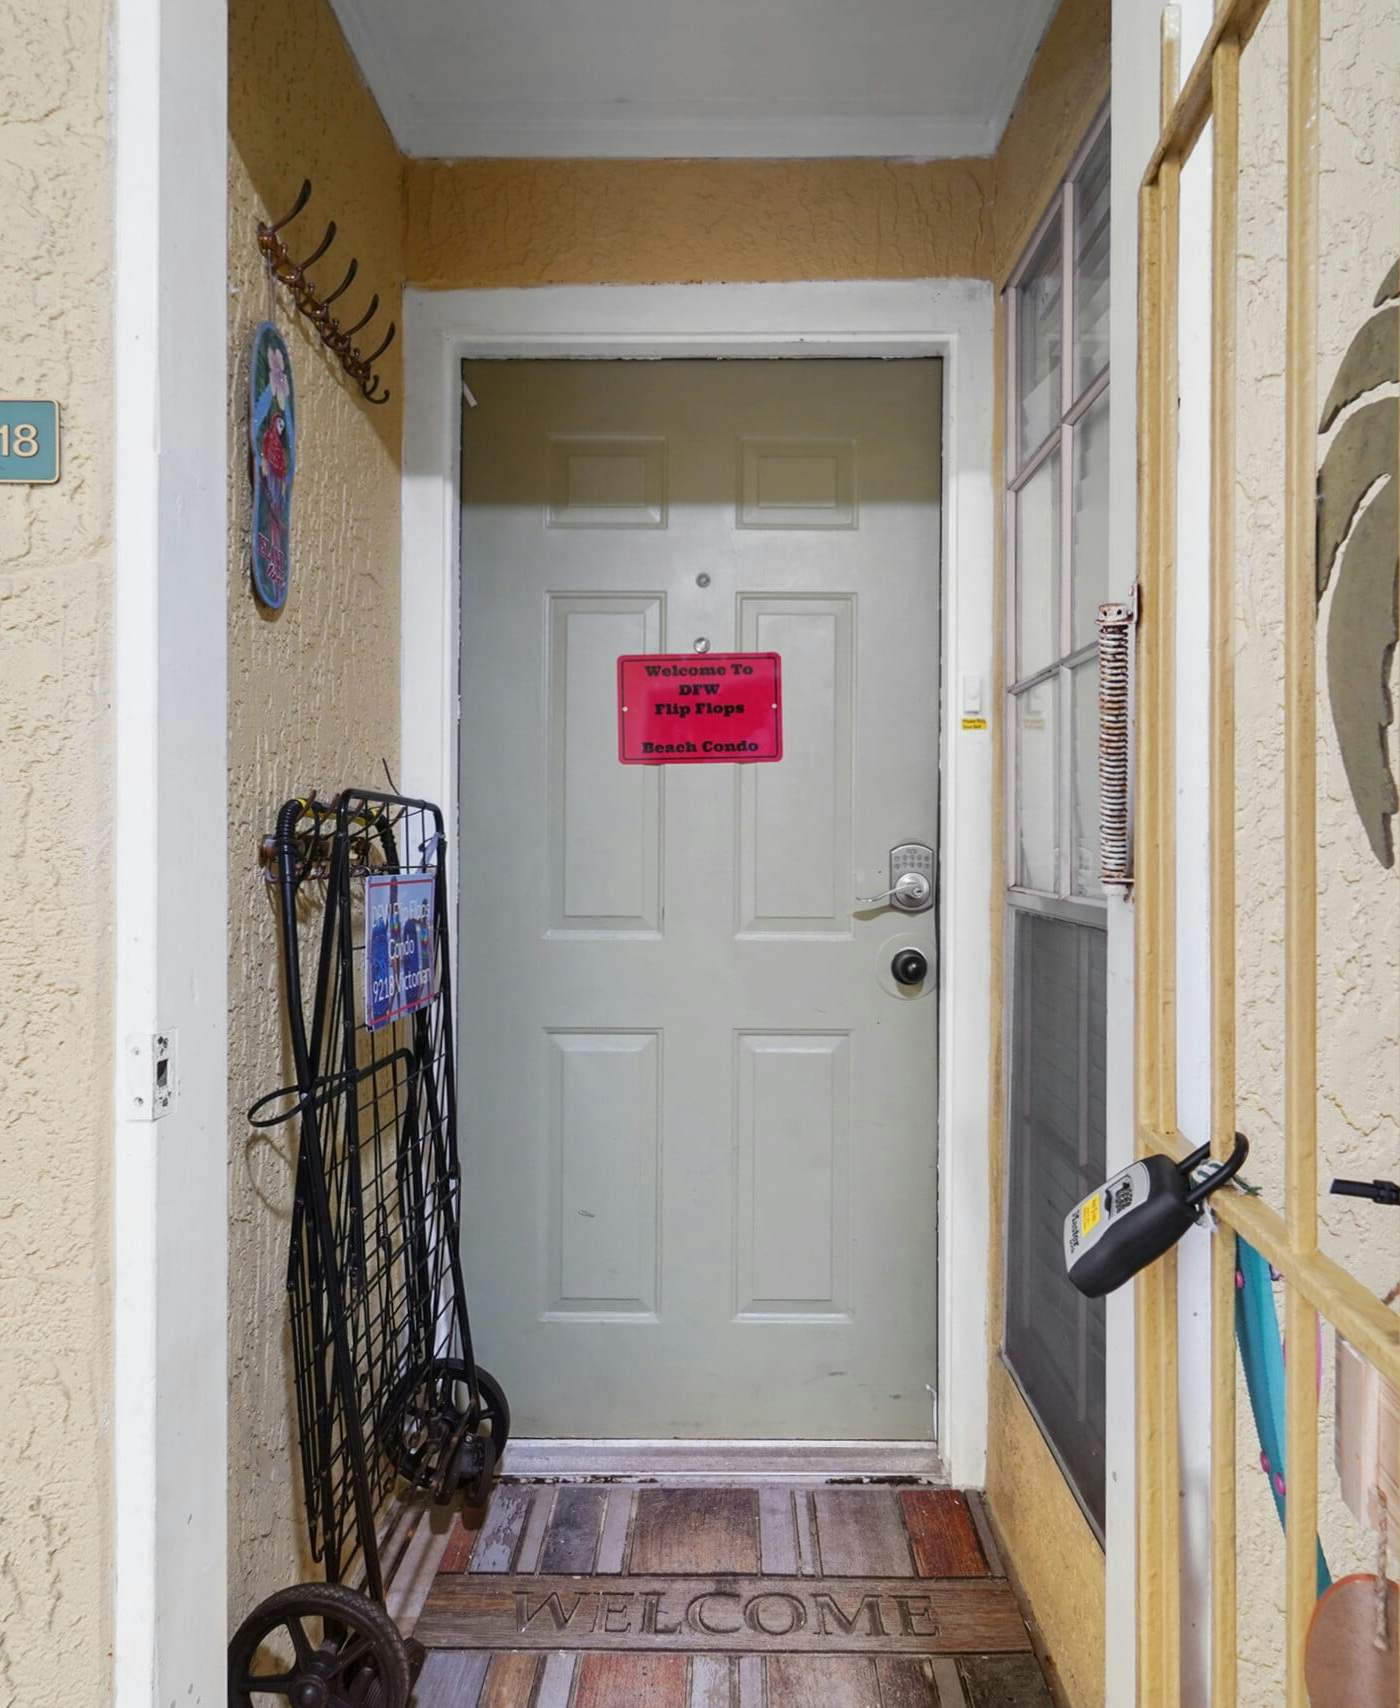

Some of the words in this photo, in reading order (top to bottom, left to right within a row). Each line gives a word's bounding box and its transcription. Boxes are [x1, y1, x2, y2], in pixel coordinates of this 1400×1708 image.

[644, 664, 726, 677] Welcome
[731, 663, 753, 675] To
[678, 684, 720, 696] DFW
[655, 704, 691, 718] Flip
[695, 702, 745, 717] Flops
[642, 741, 696, 754] Beach
[702, 740, 759, 753] Condo
[388, 938, 415, 960] Condo
[373, 975, 396, 1003] 9218
[512, 1591, 941, 1637] WELCOME
